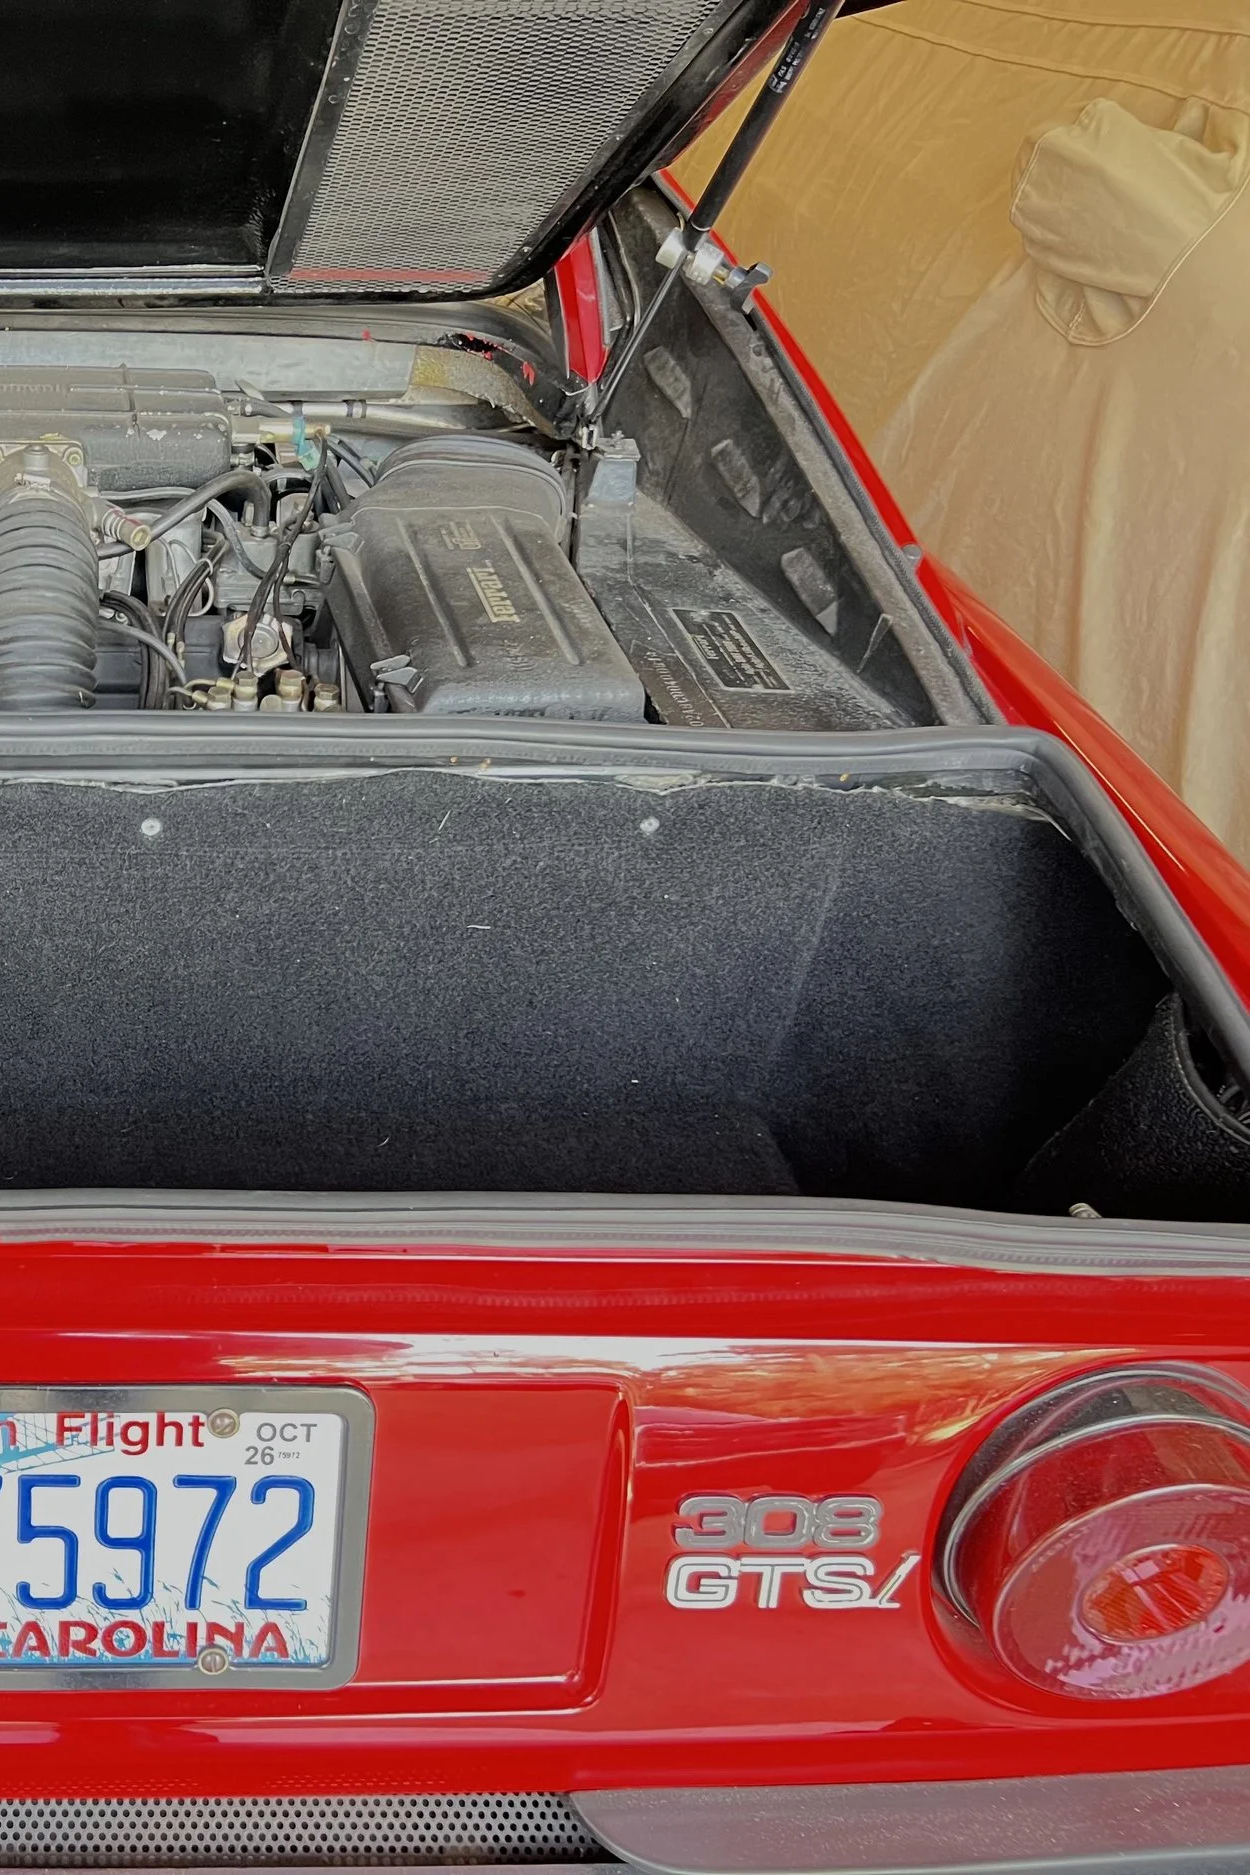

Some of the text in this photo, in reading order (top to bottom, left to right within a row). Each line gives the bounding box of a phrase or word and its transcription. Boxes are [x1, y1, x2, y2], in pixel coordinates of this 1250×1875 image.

[55, 1411, 206, 1457] Flight
[244, 1445, 301, 1466] 26 75972
[256, 1422, 318, 1443] OCT
[674, 1495, 882, 1549] 308
[665, 1552, 921, 1609] GTSi
